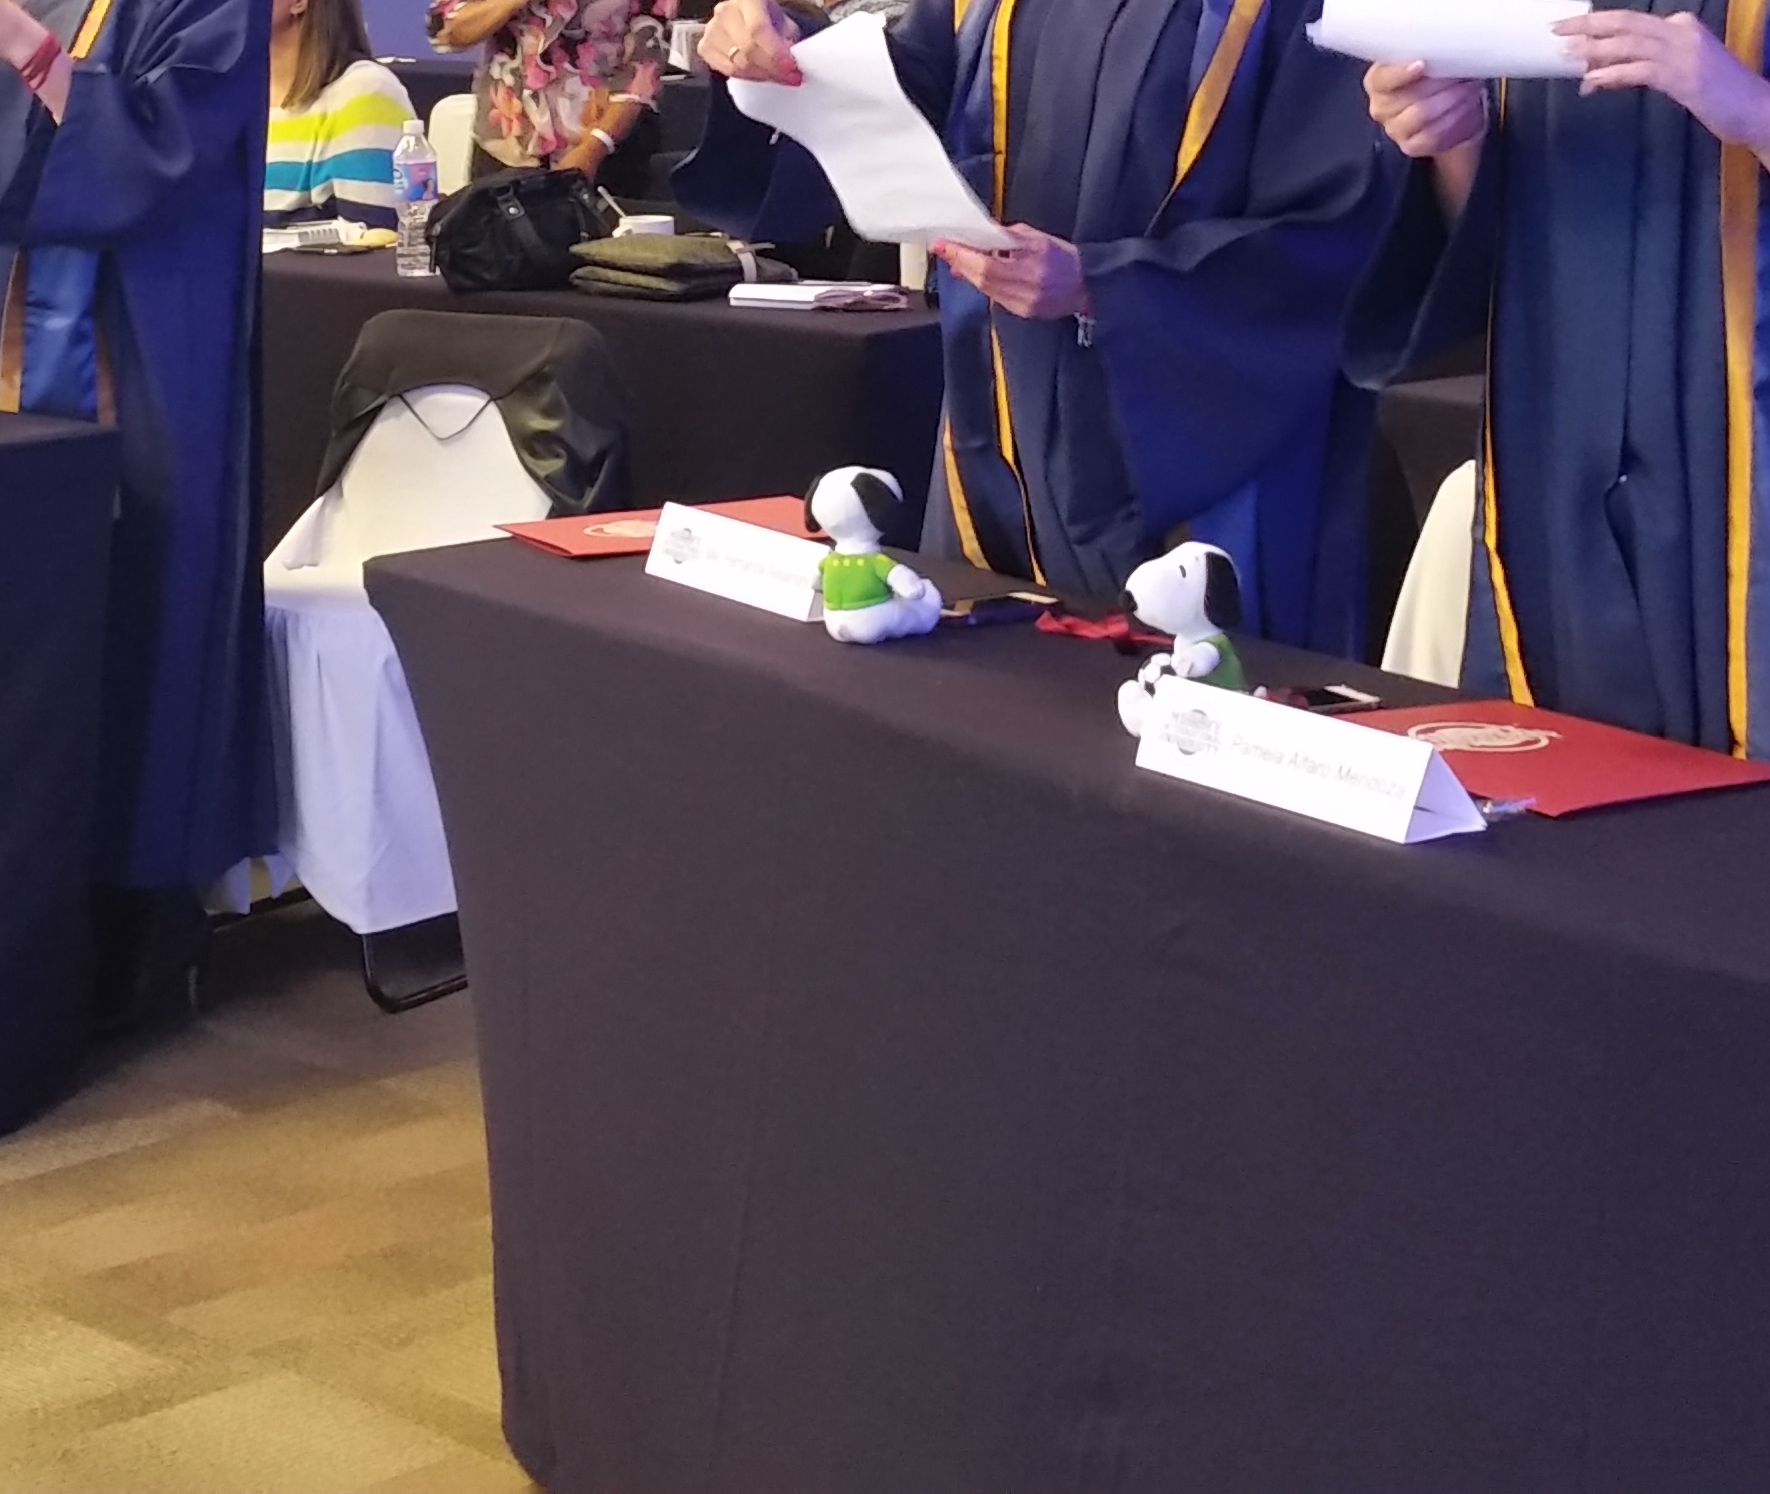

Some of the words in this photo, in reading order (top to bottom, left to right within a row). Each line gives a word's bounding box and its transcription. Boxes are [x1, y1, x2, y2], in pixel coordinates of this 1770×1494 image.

[1230, 735, 1284, 765] Pamela
[1286, 752, 1331, 778] Alfaro
[1335, 765, 1407, 800] Mendoza
